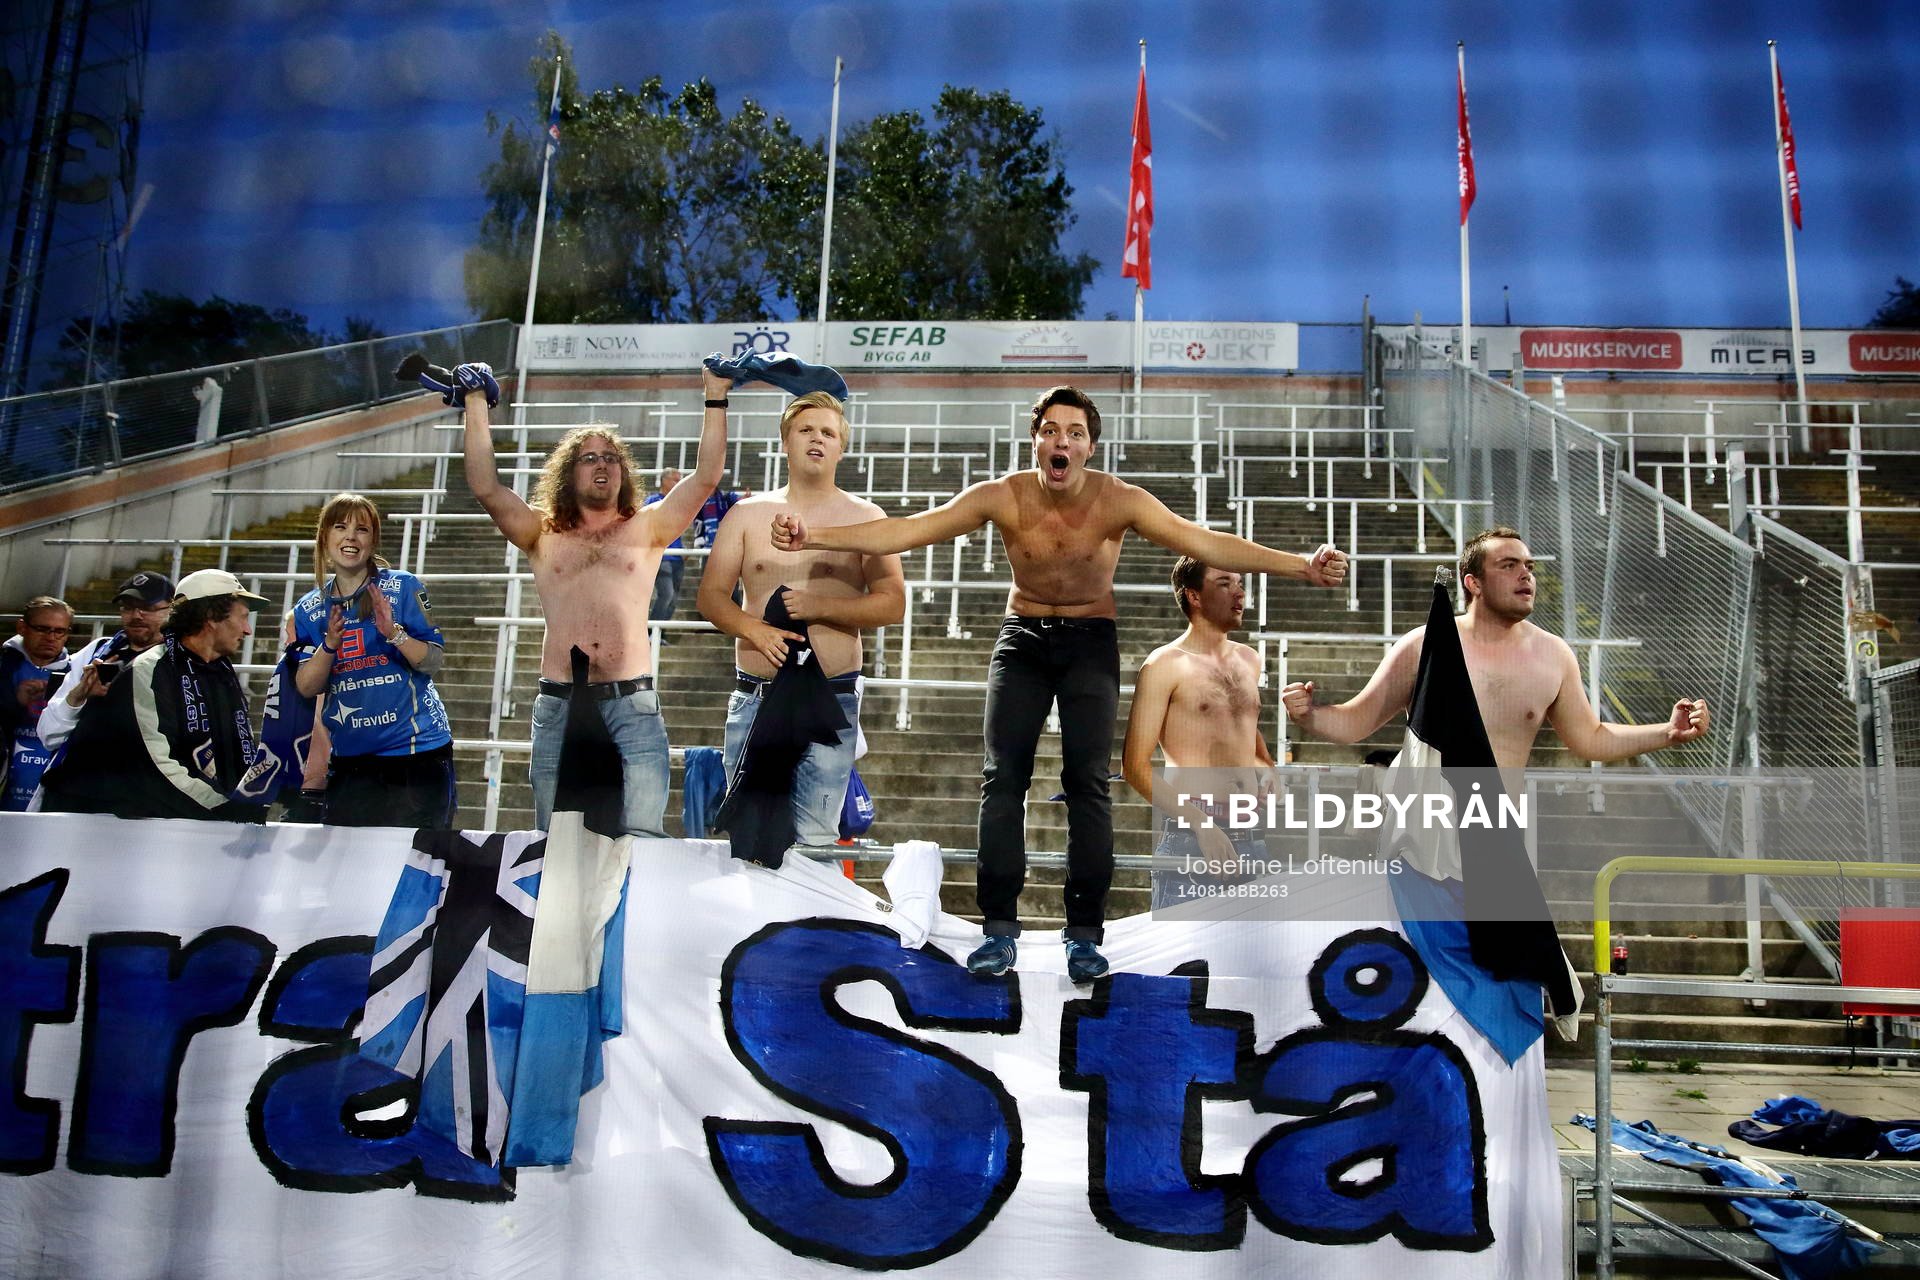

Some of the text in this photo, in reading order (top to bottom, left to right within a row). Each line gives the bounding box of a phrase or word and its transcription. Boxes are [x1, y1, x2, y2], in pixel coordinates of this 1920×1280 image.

[732, 326, 790, 356] RÖR
[850, 327, 946, 346] SEFAB
[1148, 327, 1276, 340] VENTILATIONS
[585, 337, 640, 350] NOVA
[1148, 341, 1276, 361] PROJEKT
[1531, 342, 1672, 359] MUSIKSERVICE
[864, 351, 931, 362] BYGG AB
[351, 709, 397, 728] bravida
[21, 753, 49, 765] brav
[702, 917, 1495, 1271] Stå
